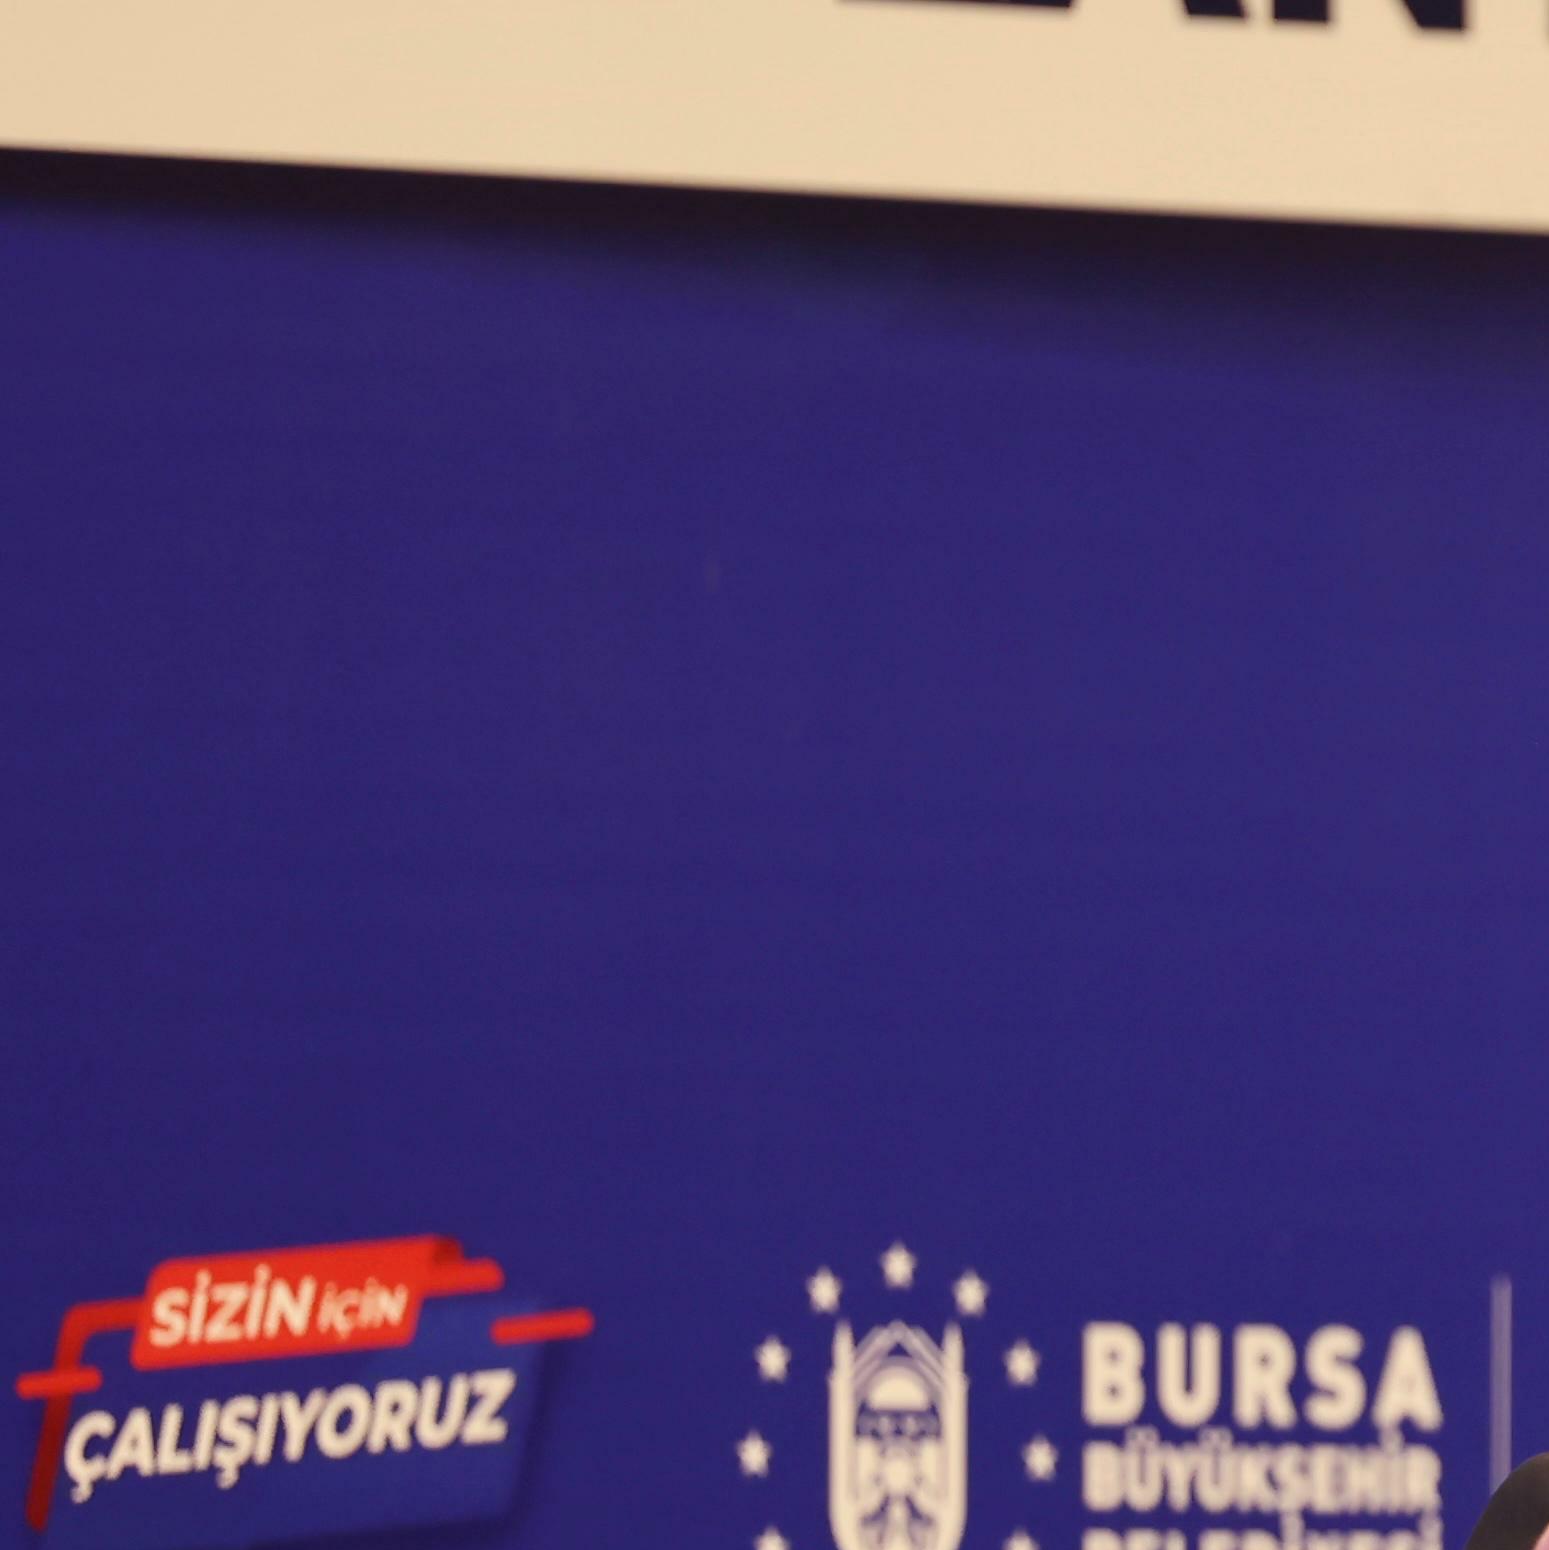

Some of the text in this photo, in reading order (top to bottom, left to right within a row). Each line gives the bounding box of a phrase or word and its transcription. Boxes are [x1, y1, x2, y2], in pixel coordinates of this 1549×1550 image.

[149, 1264, 409, 1348] SİZİN İÇİN
[1082, 1322, 1443, 1431] BURSA
[64, 1368, 517, 1503] ÇALIŞIYORUZ
[1082, 1424, 1443, 1518] BÜYÜKŞEHİR
